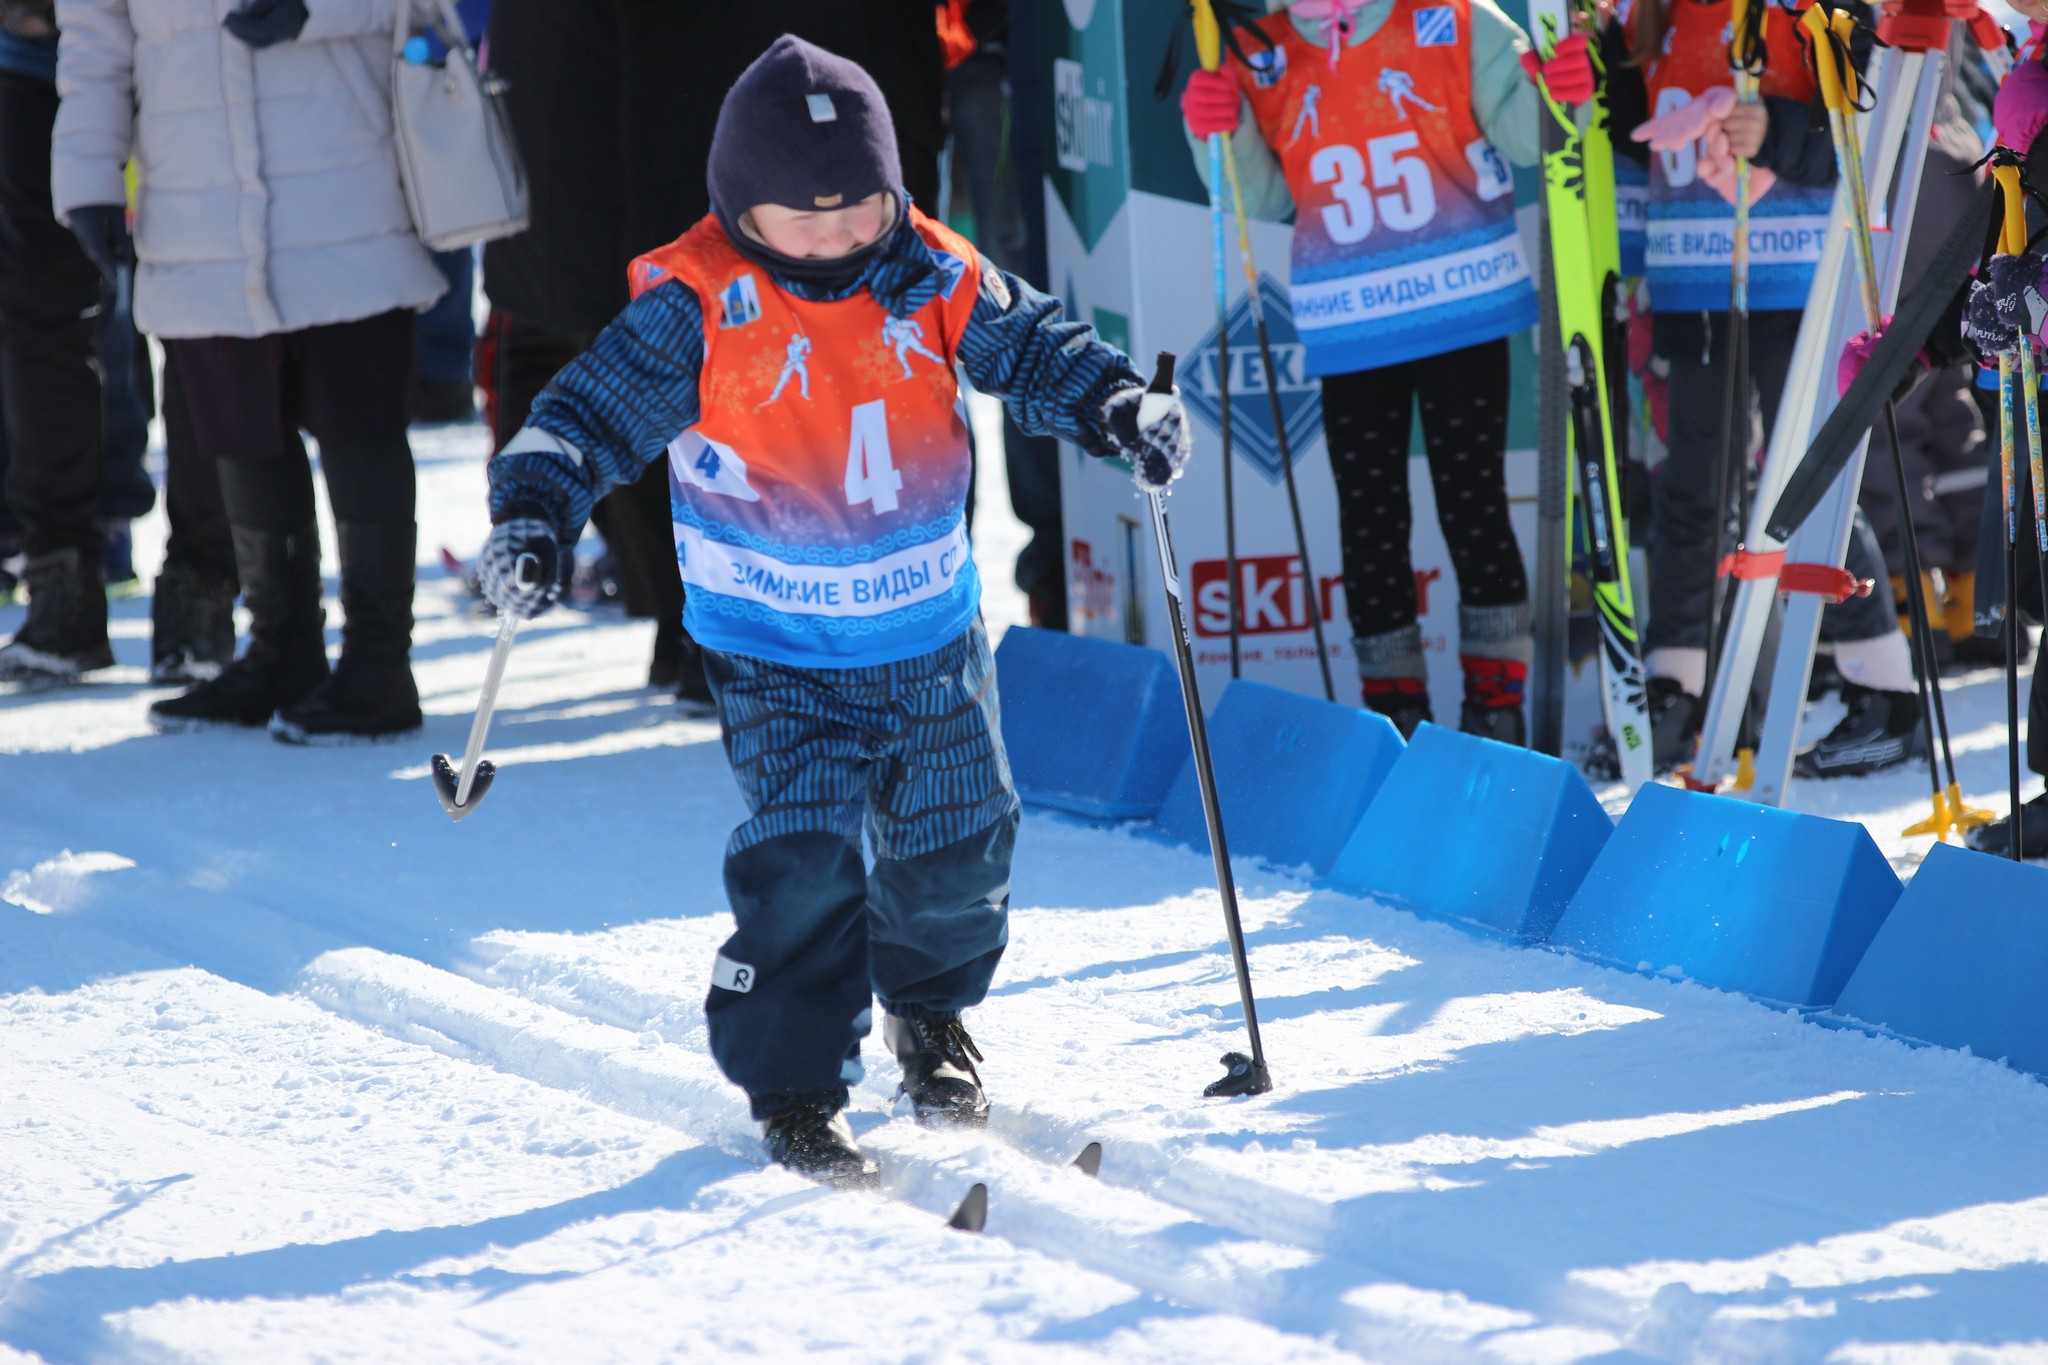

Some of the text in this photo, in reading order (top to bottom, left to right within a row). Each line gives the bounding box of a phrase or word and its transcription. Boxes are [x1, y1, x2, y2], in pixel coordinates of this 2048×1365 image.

[1311, 131, 1437, 245] 35
[1749, 228, 1827, 254] СПОРТ
[1360, 273, 1437, 310] ВИДЫ
[694, 442, 721, 480] 4
[844, 399, 903, 516] 4
[730, 561, 840, 606] ЗИМНИЕ
[852, 559, 931, 604] ВИДЫ
